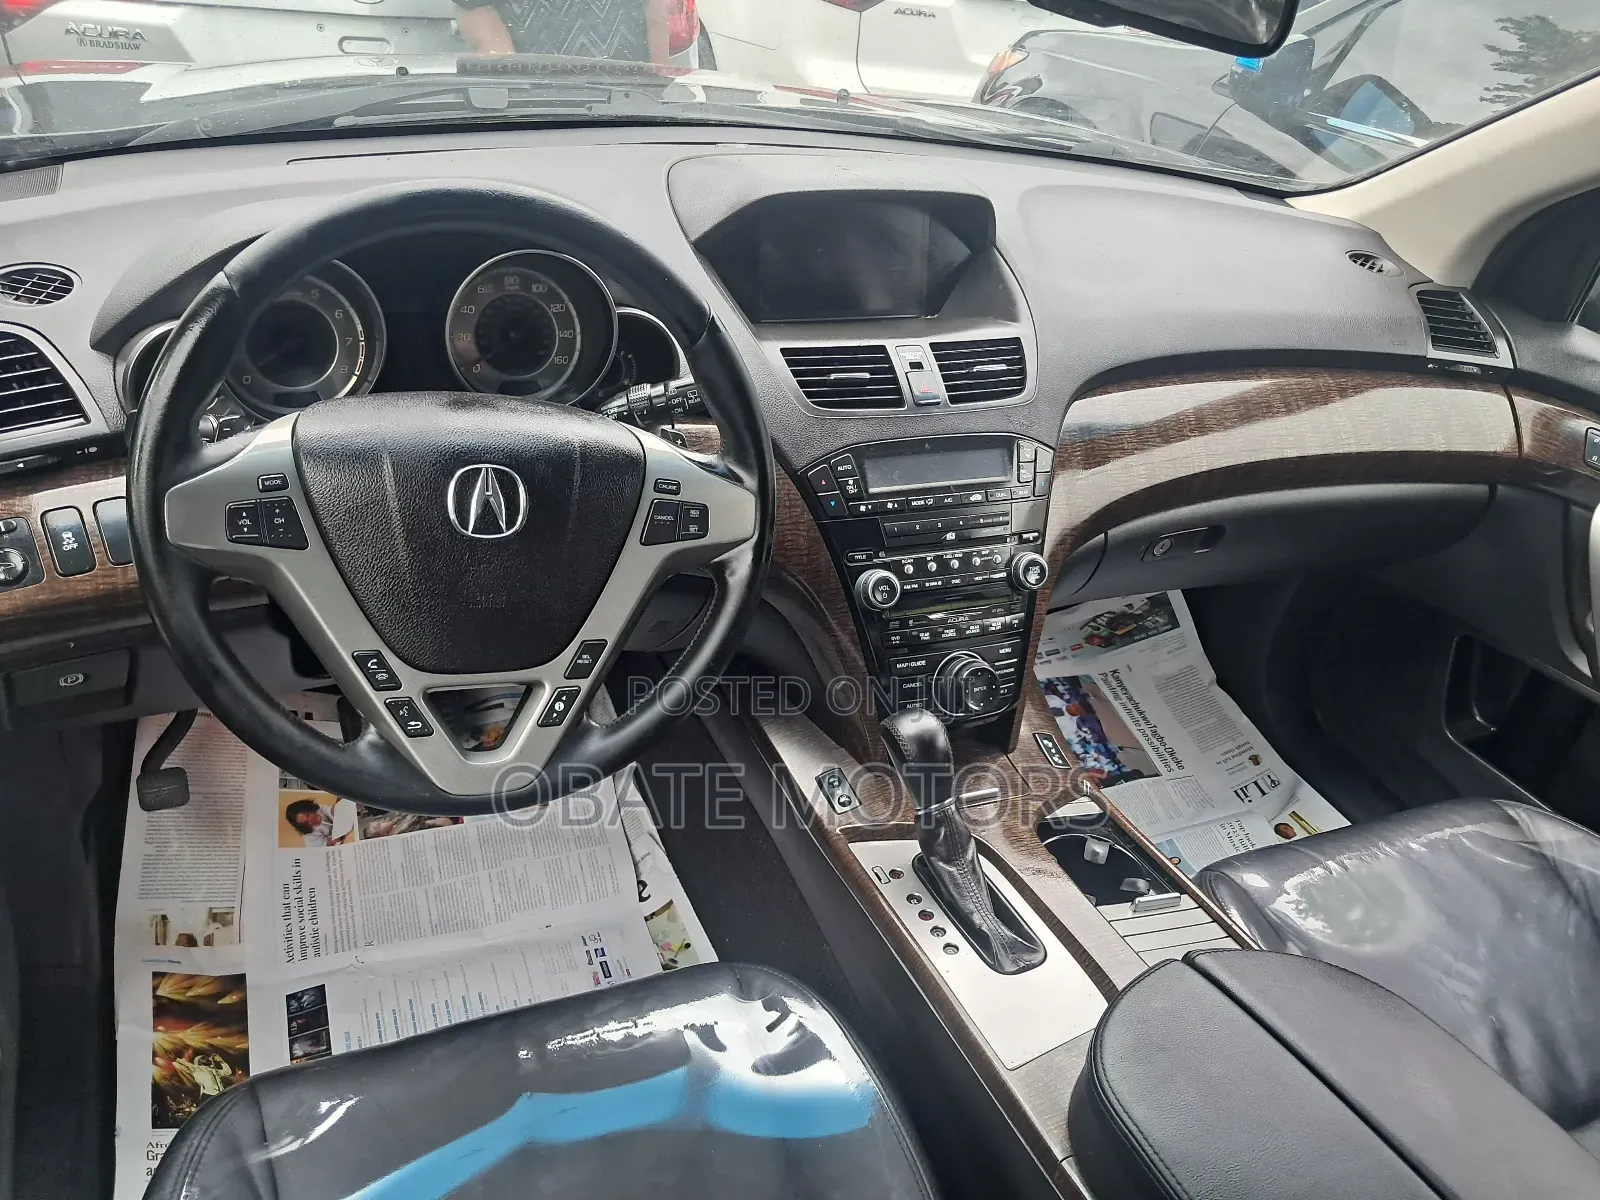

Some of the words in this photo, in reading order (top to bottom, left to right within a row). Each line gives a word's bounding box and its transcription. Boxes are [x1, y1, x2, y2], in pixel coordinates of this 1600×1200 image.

[893, 6, 936, 18] ACURA
[65, 21, 148, 41] ACURA
[89, 39, 140, 50] BRADSHAW
[532, 284, 548, 293] 100
[460, 305, 475, 314] 40
[550, 303, 566, 312] 120
[334, 309, 343, 319] 6
[559, 330, 574, 338] 140
[345, 337, 353, 347] 7
[554, 356, 569, 364] 160
[472, 364, 481, 373] 0
[837, 464, 853, 472] AUTO
[237, 518, 253, 526] VOL
[62, 542, 79, 551] OFF
[902, 681, 924, 689] CANCEL
[1119, 702, 1142, 728] infinite
[1136, 728, 1175, 773] possibilities
[1237, 838, 1251, 851] Bill
[1243, 832, 1257, 849] look
[291, 858, 301, 868] in
[292, 869, 303, 895] skills
[282, 883, 291, 900] can
[282, 902, 292, 921] that
[293, 896, 305, 924] social
[307, 887, 319, 926] children
[283, 923, 296, 964] Activities
[298, 925, 310, 961] improve
[309, 927, 321, 958] autistic
